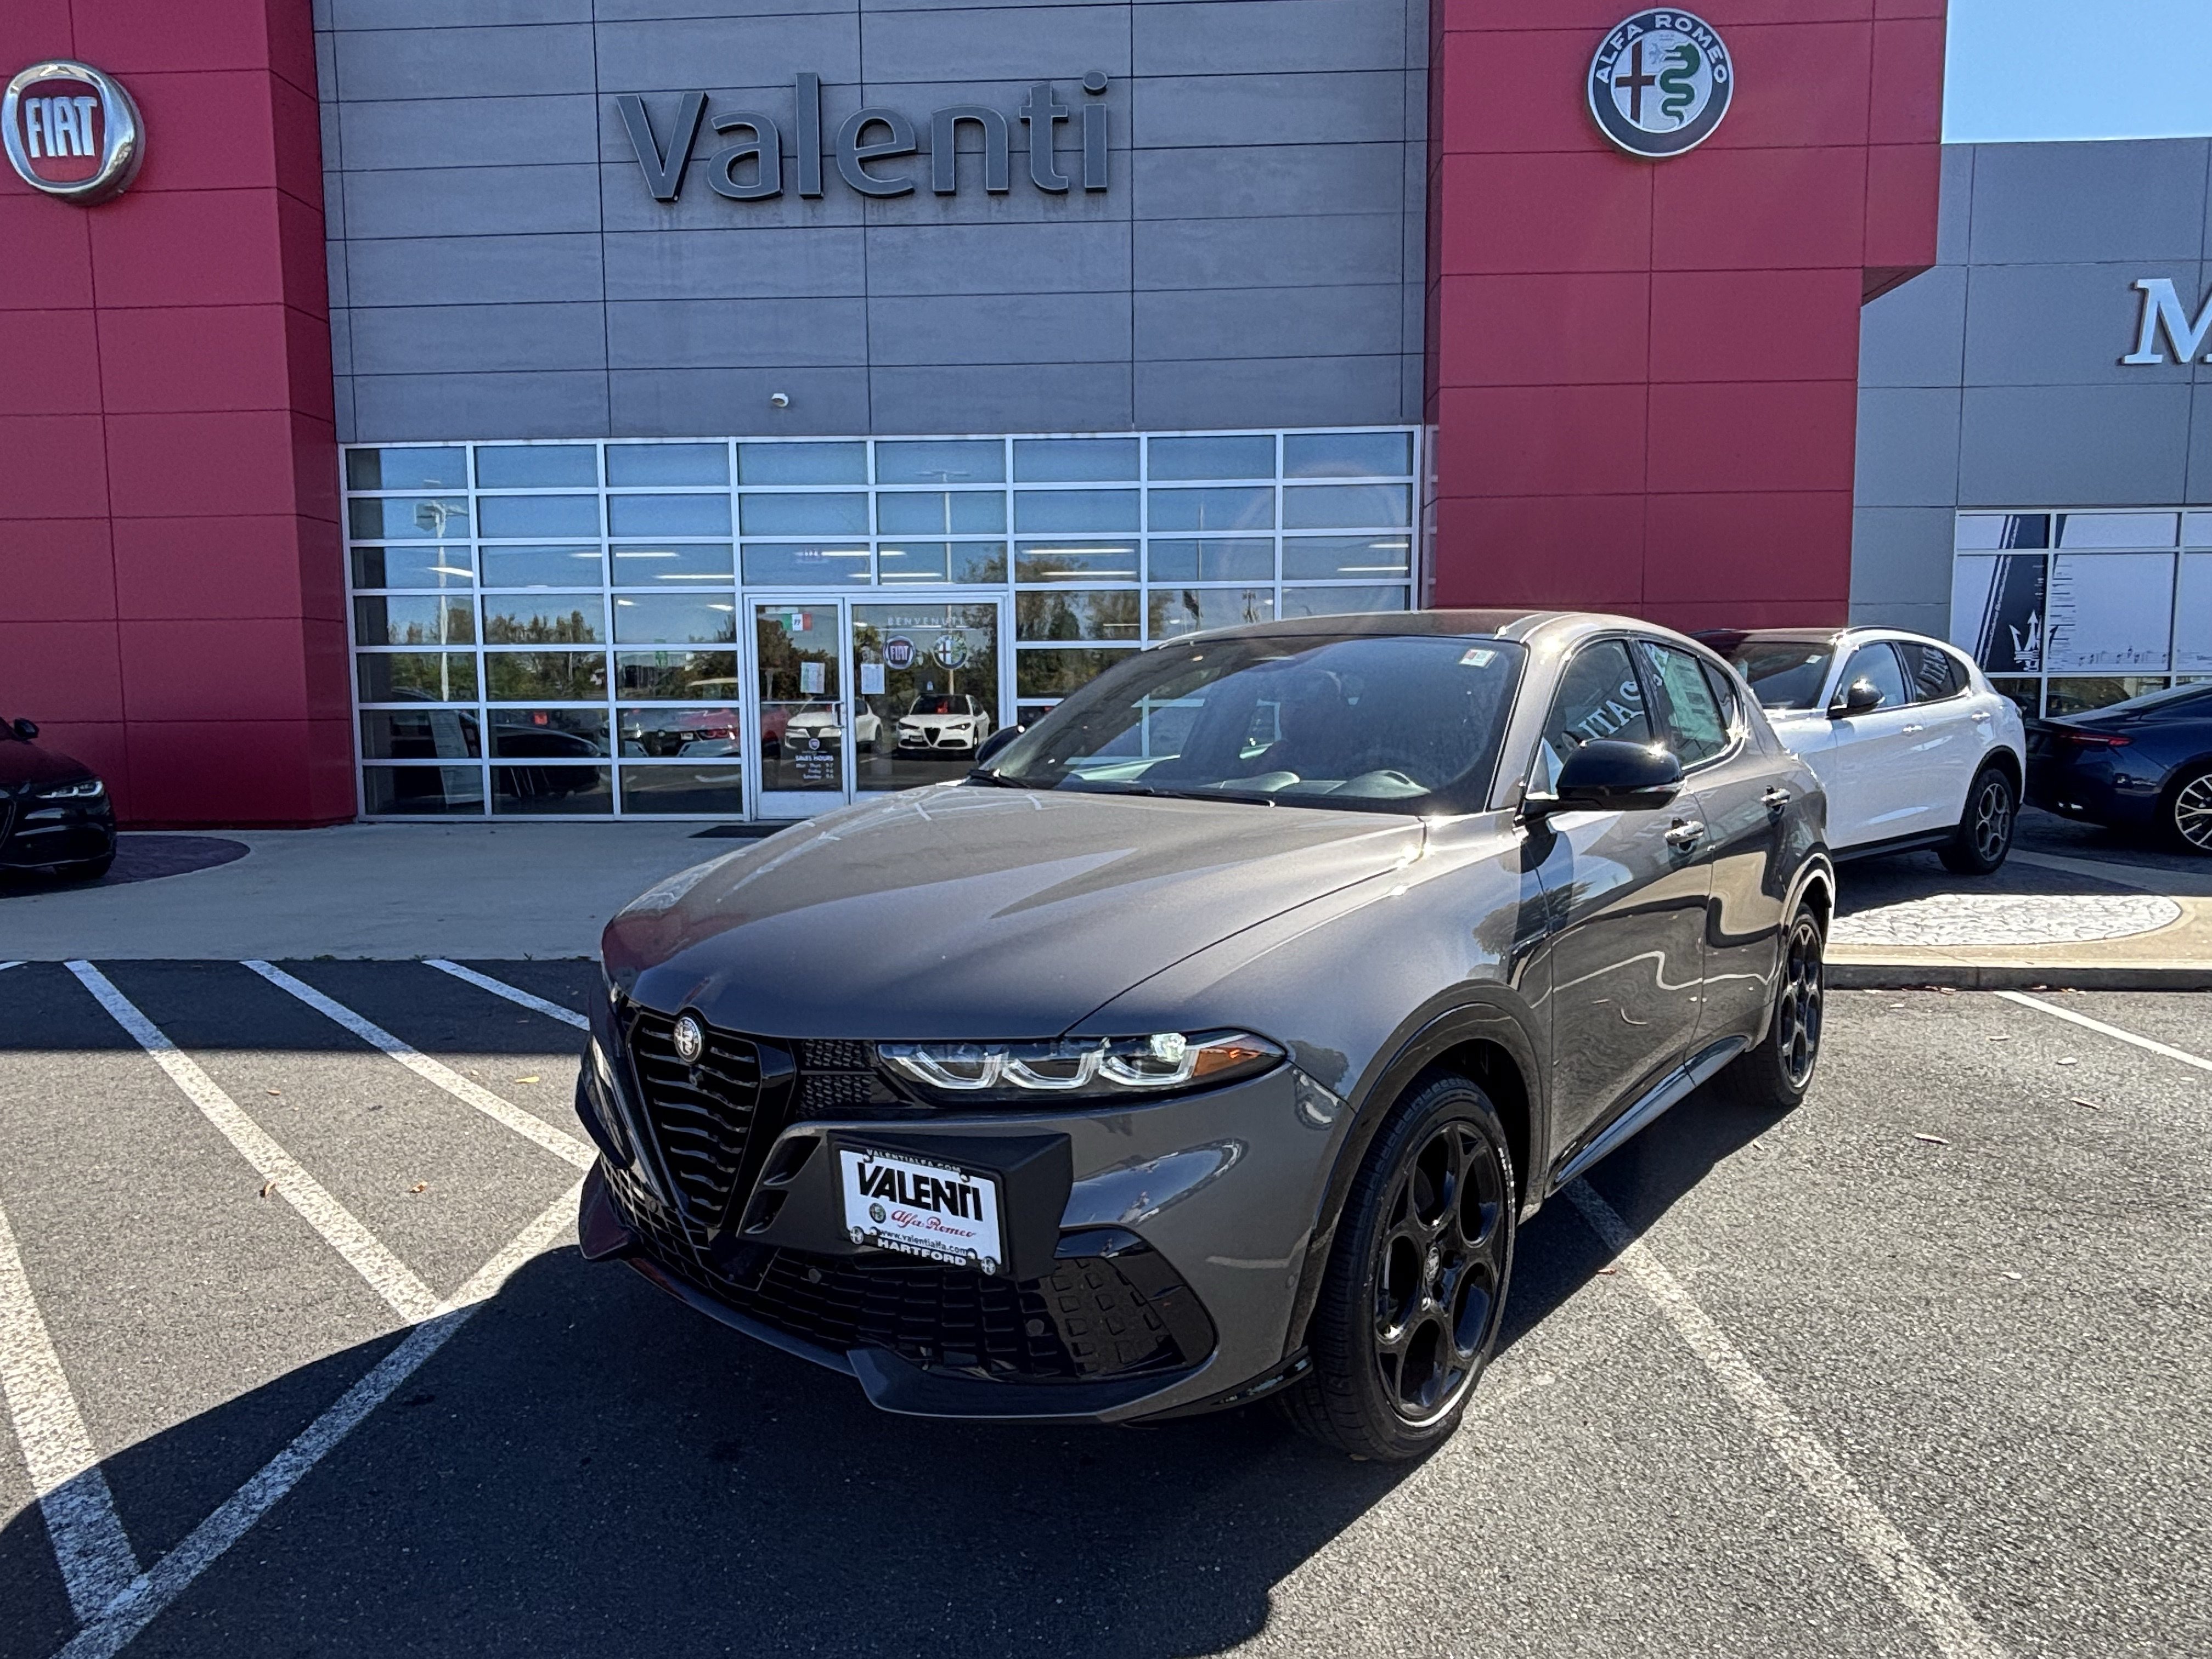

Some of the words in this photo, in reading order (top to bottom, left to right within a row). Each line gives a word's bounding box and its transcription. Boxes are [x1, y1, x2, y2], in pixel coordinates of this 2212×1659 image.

[1595, 23, 1643, 83] ALFA
[1655, 14, 1728, 83] ROMEO
[25, 96, 98, 158] FIAT
[614, 69, 1108, 202] Valenti
[888, 617, 964, 625] BENVENUTI
[890, 645, 909, 661] FIAT
[857, 1162, 983, 1222] VALENTI
[891, 1210, 925, 1229] Alfa
[926, 1216, 977, 1238] Romeo
[878, 1238, 967, 1266] HARTFORD
[880, 1229, 968, 1256] www.valentialfa.com
